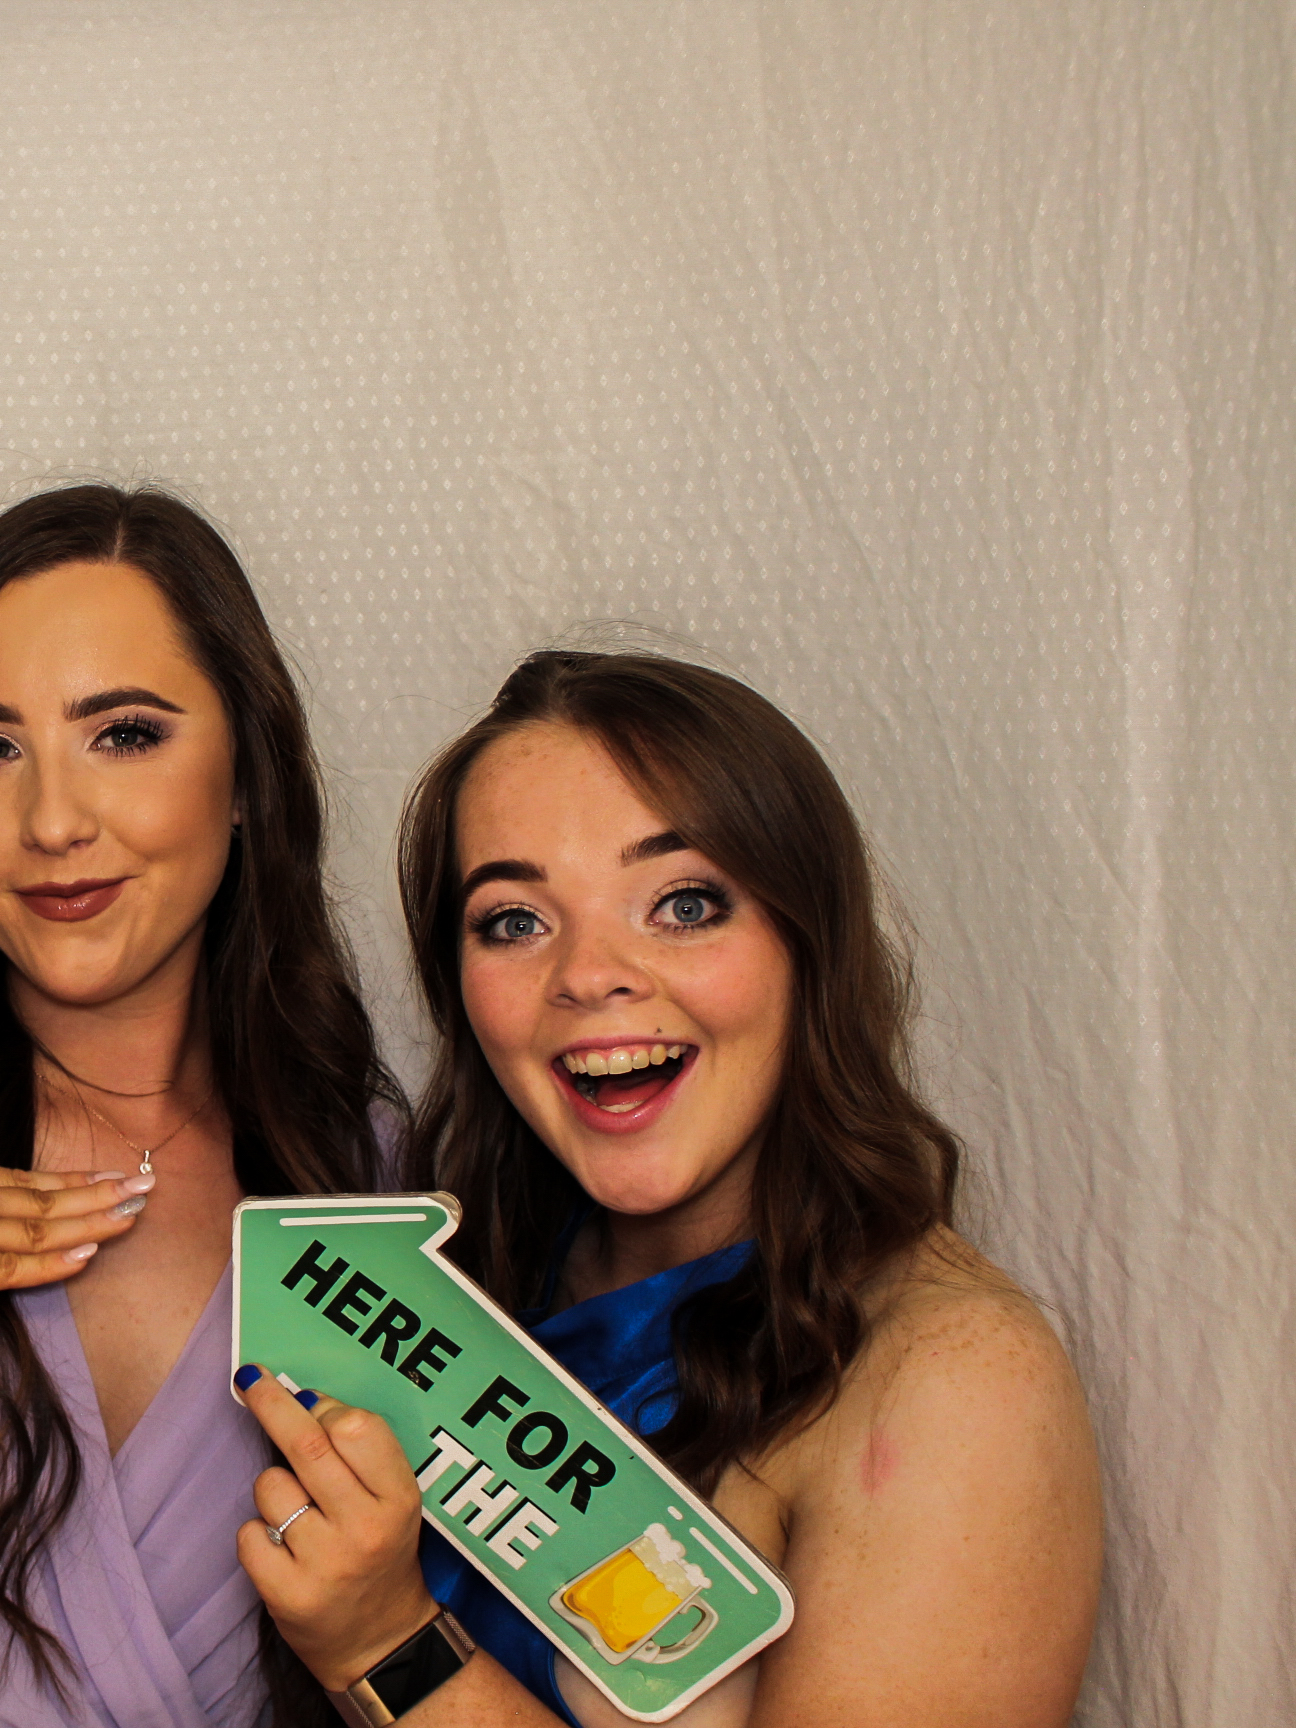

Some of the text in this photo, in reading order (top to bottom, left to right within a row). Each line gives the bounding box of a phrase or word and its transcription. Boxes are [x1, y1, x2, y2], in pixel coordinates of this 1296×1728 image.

[280, 1239, 616, 1514] HERE FOR
[415, 1425, 560, 1570] THE
